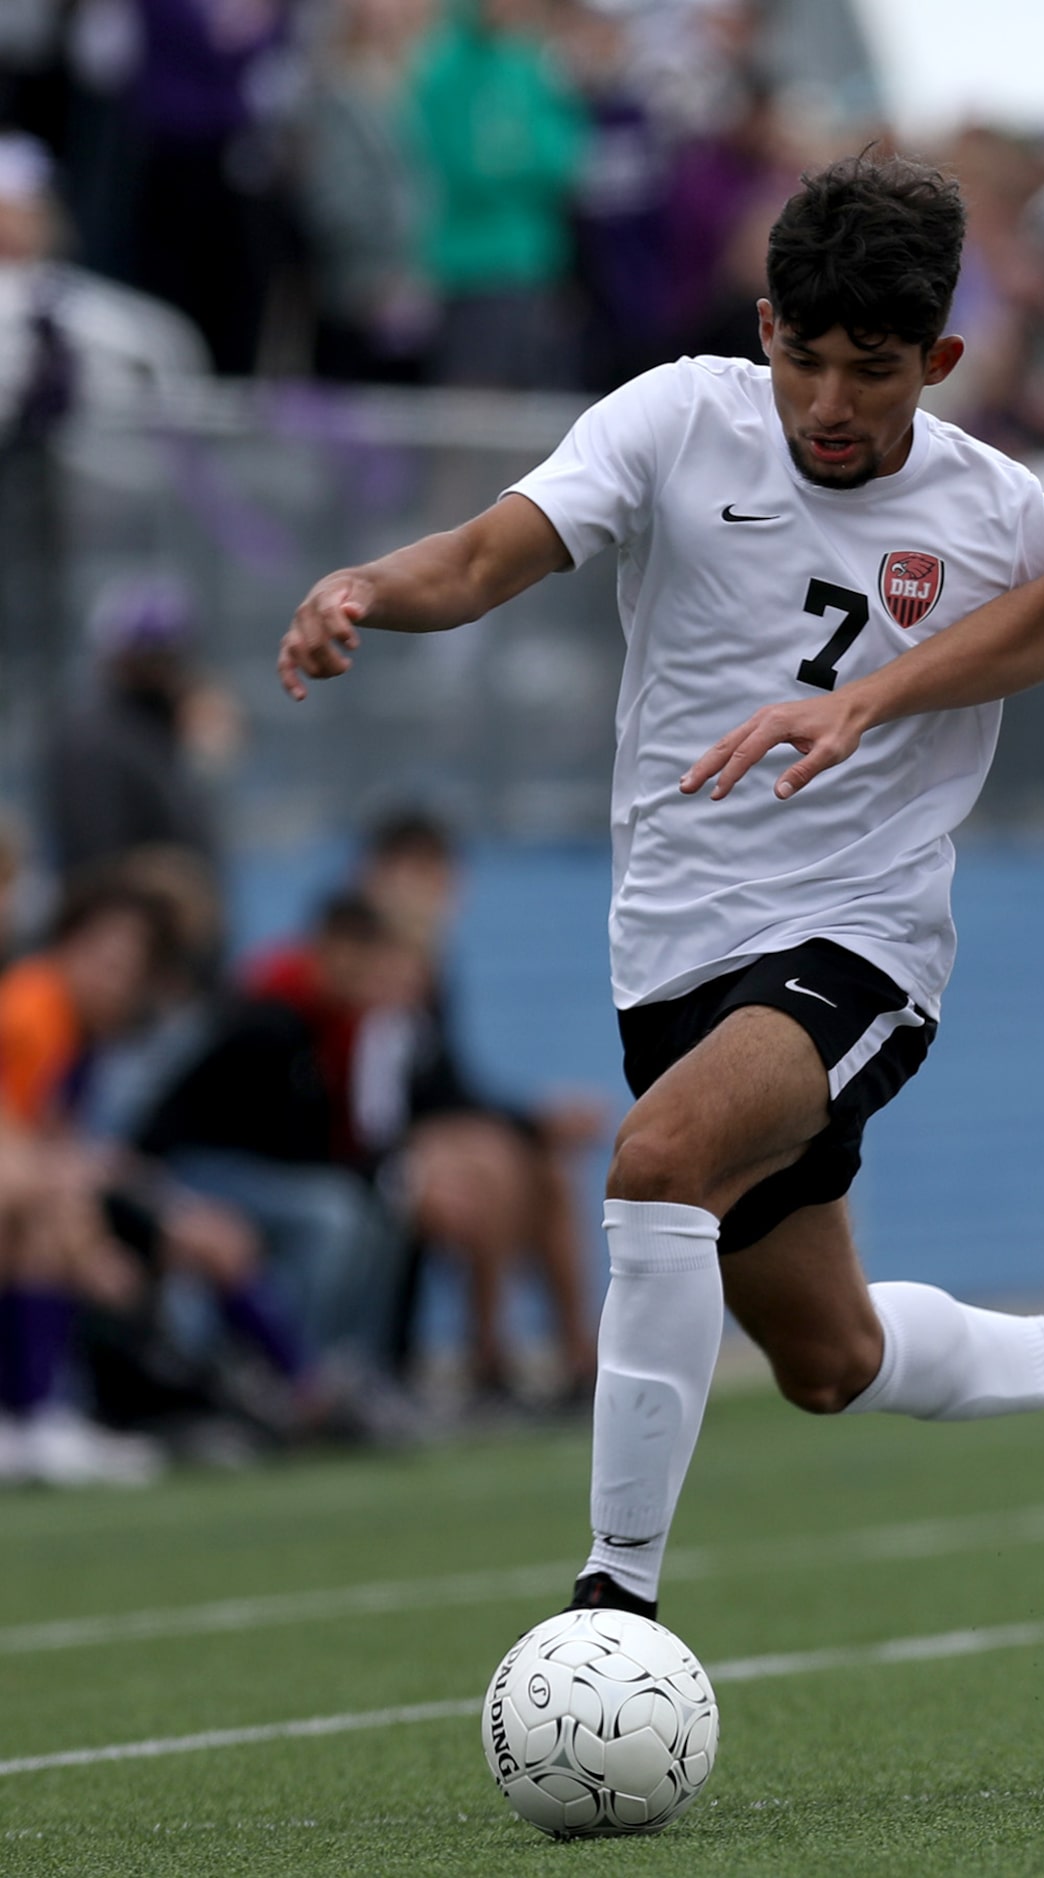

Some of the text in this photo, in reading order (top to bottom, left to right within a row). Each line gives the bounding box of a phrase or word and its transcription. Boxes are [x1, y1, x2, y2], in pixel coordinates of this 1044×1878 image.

[796, 577, 870, 692] 7
[889, 578, 932, 600] DHJ
[489, 1632, 536, 1780] PALDING
